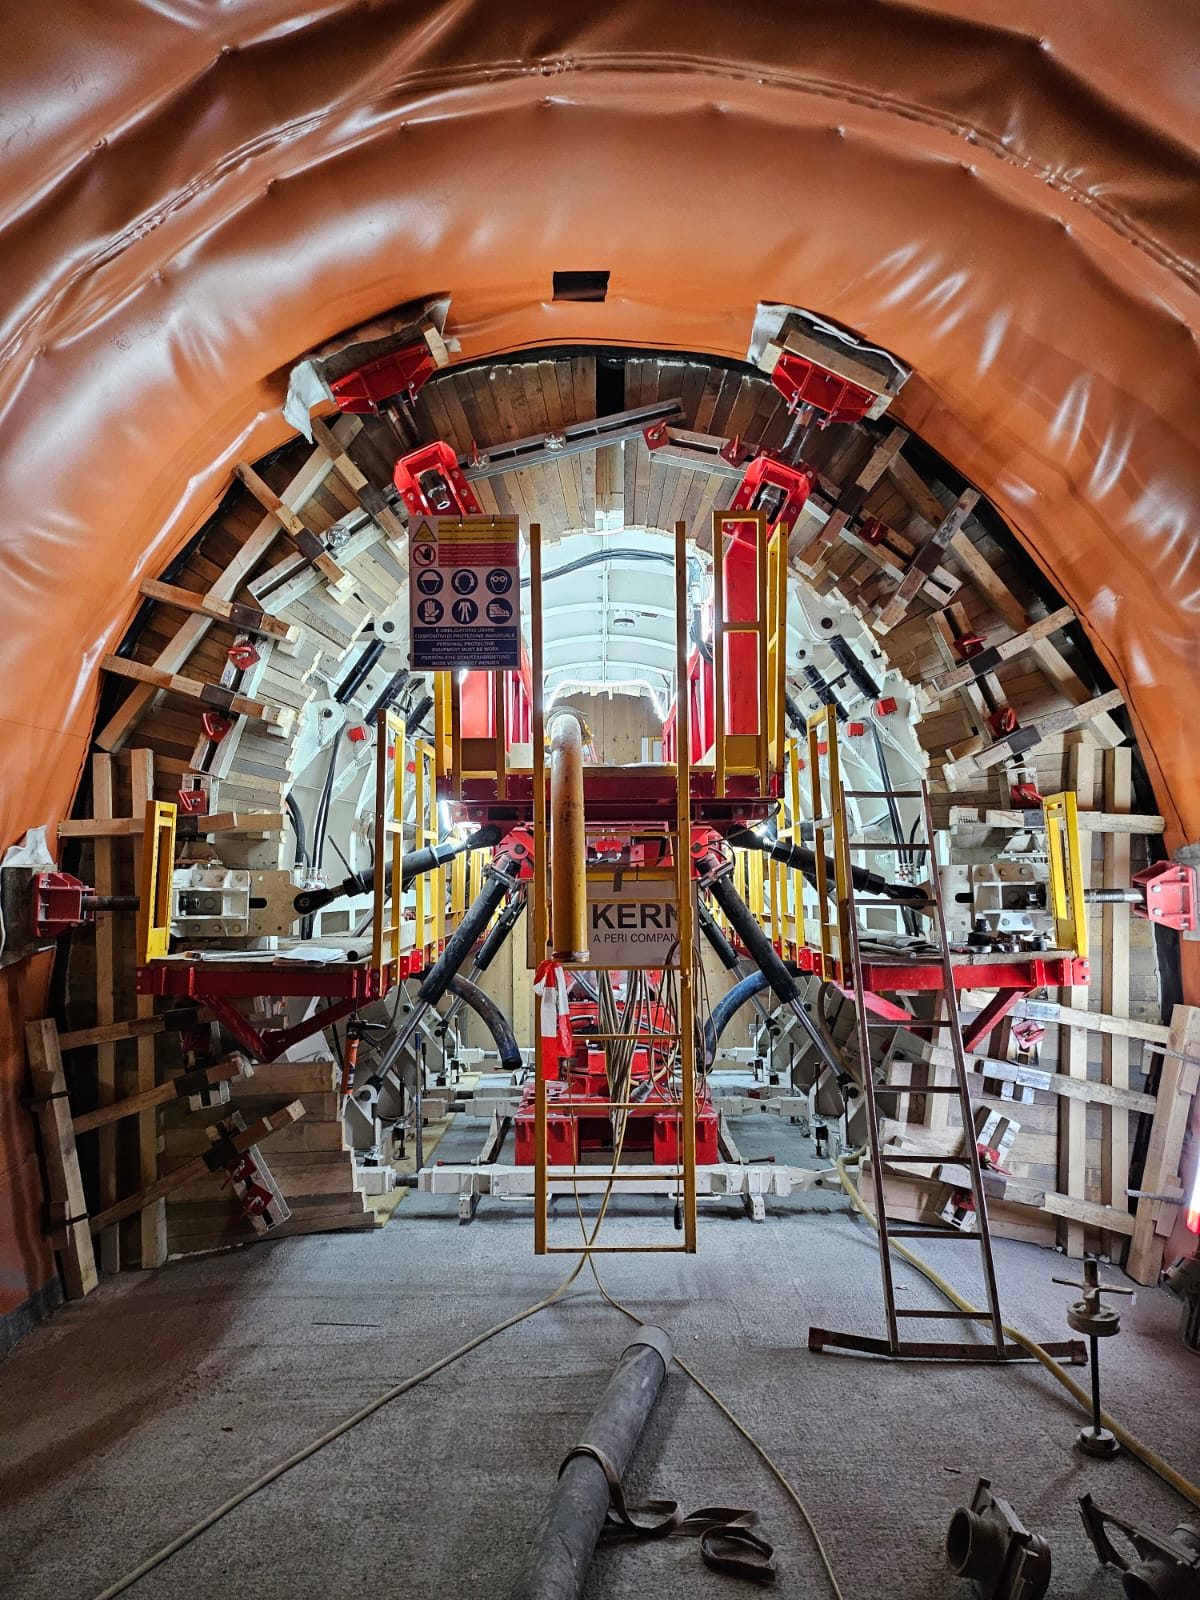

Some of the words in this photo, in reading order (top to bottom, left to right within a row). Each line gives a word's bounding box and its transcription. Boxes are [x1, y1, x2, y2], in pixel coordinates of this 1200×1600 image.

[593, 903, 678, 929] KERN
[593, 933, 601, 944] A
[604, 933, 628, 944] PERI
[630, 933, 678, 944] COMPAN
